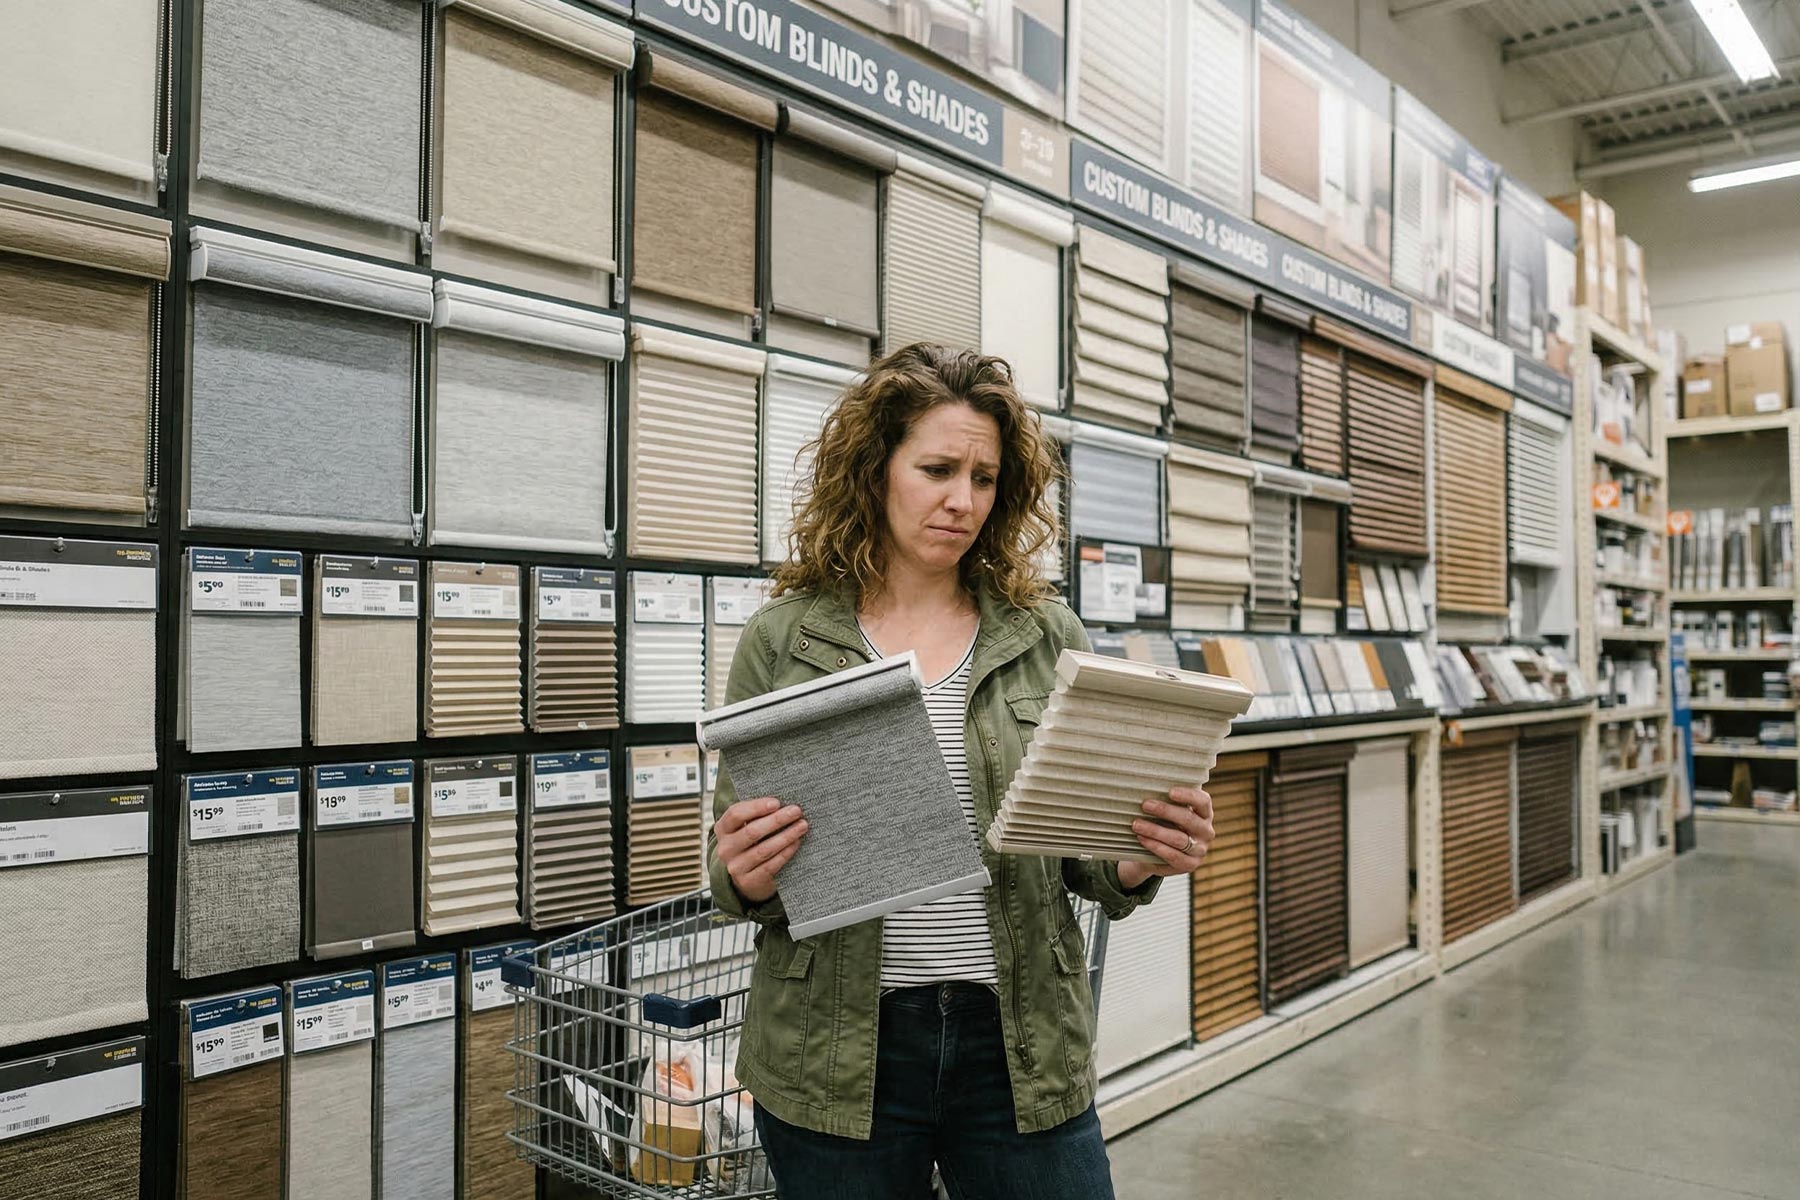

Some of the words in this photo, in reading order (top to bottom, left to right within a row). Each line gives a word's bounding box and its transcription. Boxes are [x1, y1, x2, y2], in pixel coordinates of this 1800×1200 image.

[662, 0, 781, 53] USTOM
[789, 17, 879, 96] BLINDS
[883, 68, 902, 108] &
[906, 79, 989, 146] SHADES
[1083, 161, 1149, 217] CUSTOM
[1151, 191, 1204, 241] BLINDS
[1205, 217, 1218, 249] &
[1218, 221, 1270, 269] SHADES
[193, 807, 224, 821] $1599
[297, 1015, 323, 1031] $1599
[196, 1037, 225, 1054] $1599
